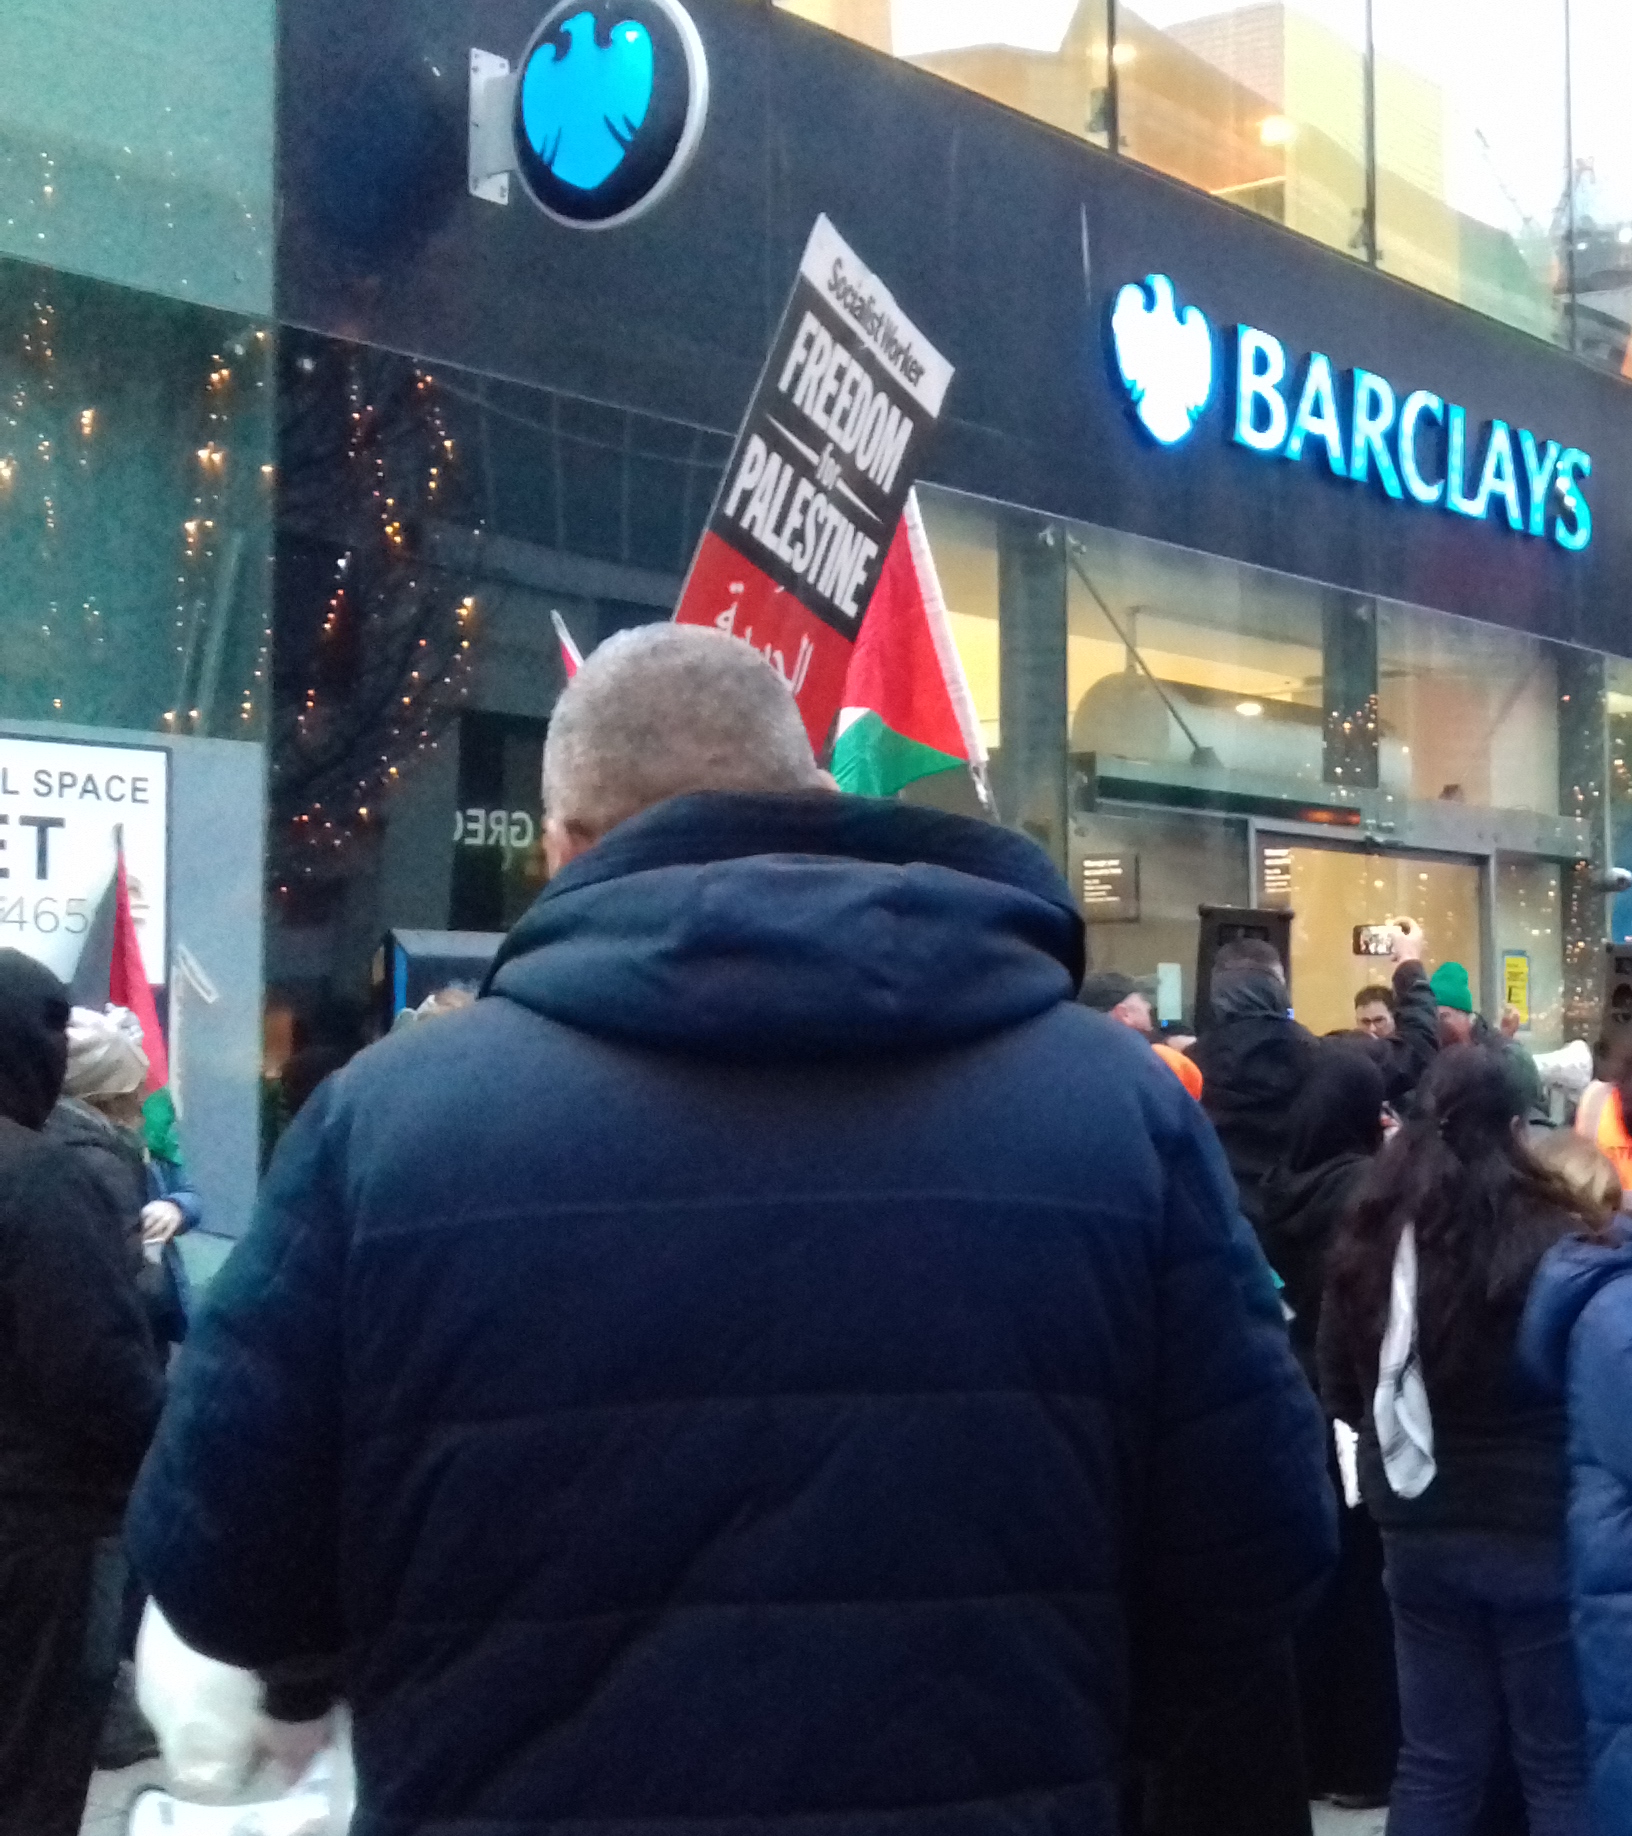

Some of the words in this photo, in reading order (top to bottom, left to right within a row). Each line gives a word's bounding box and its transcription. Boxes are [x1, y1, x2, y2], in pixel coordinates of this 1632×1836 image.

[777, 310, 913, 494] FREEDOM
[1231, 323, 1593, 551] BARCLAYS
[814, 442, 842, 492] for
[723, 433, 879, 619] PALESTINE
[33, 769, 150, 804] SPACE
[0, 895, 90, 934] 465
